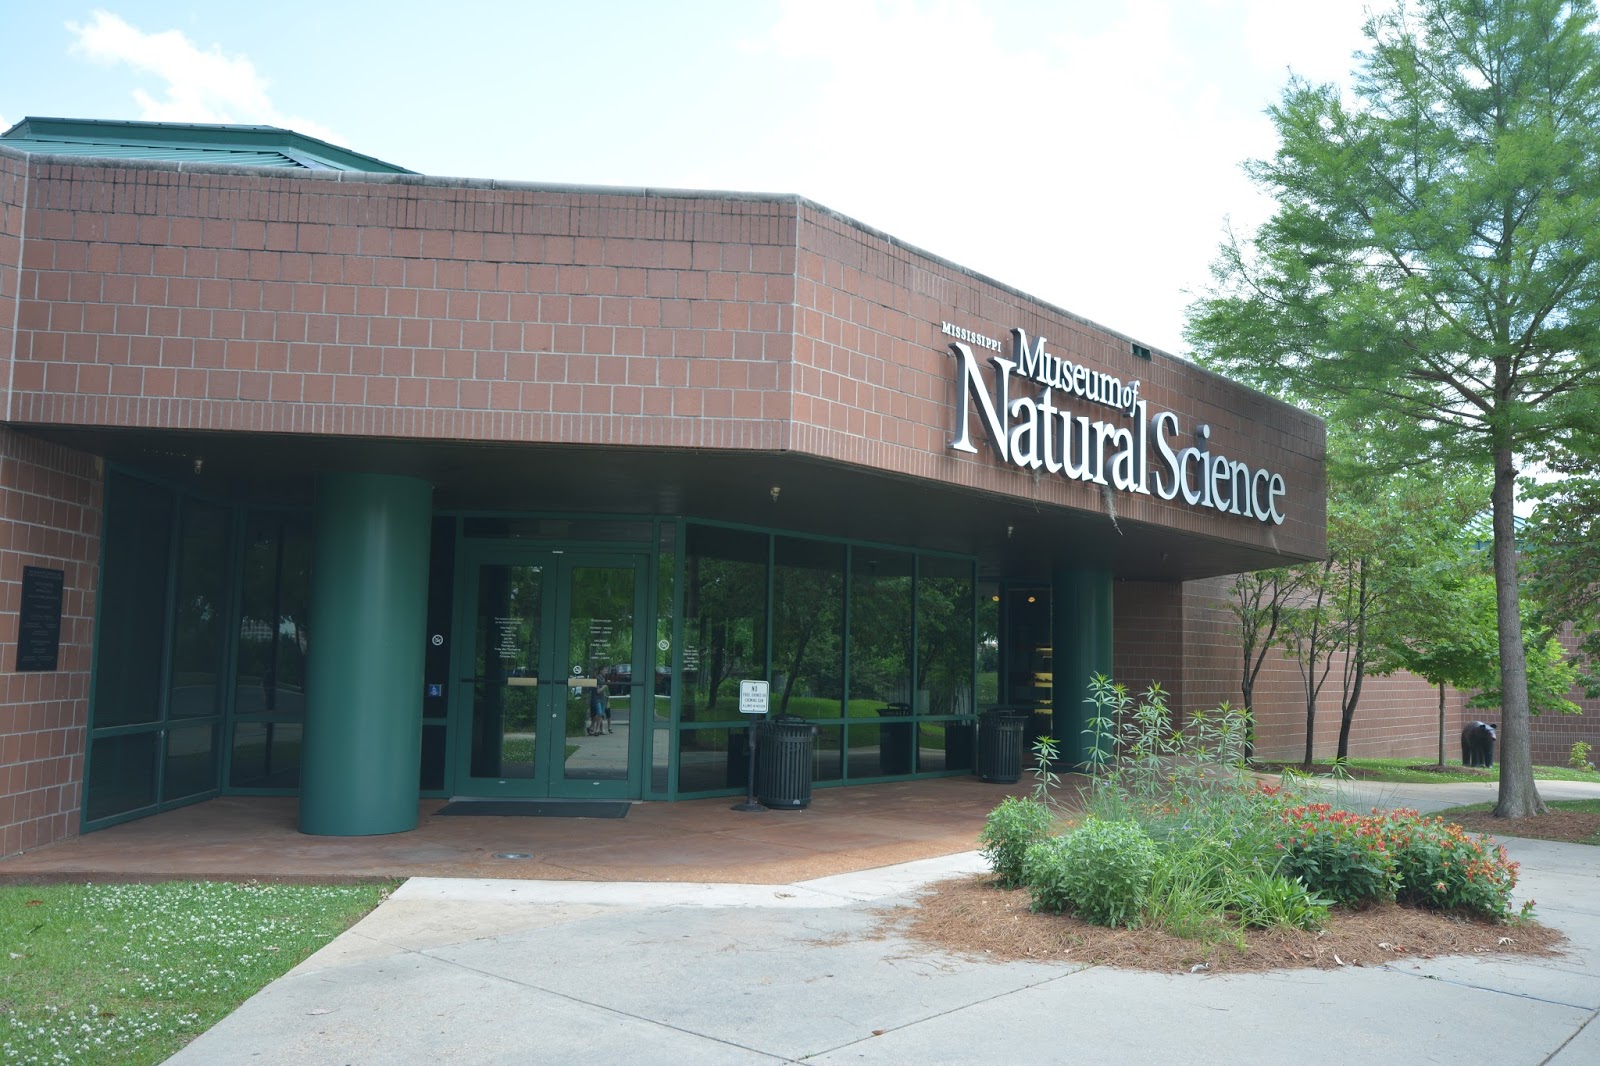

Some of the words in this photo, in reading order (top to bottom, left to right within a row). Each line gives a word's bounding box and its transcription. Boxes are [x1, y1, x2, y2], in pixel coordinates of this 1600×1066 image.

[941, 320, 1002, 353] MISSISSIPPI
[1010, 327, 1124, 410] Museum
[1123, 380, 1141, 418] of
[947, 341, 1151, 496] Natural
[1151, 411, 1287, 526] Science
